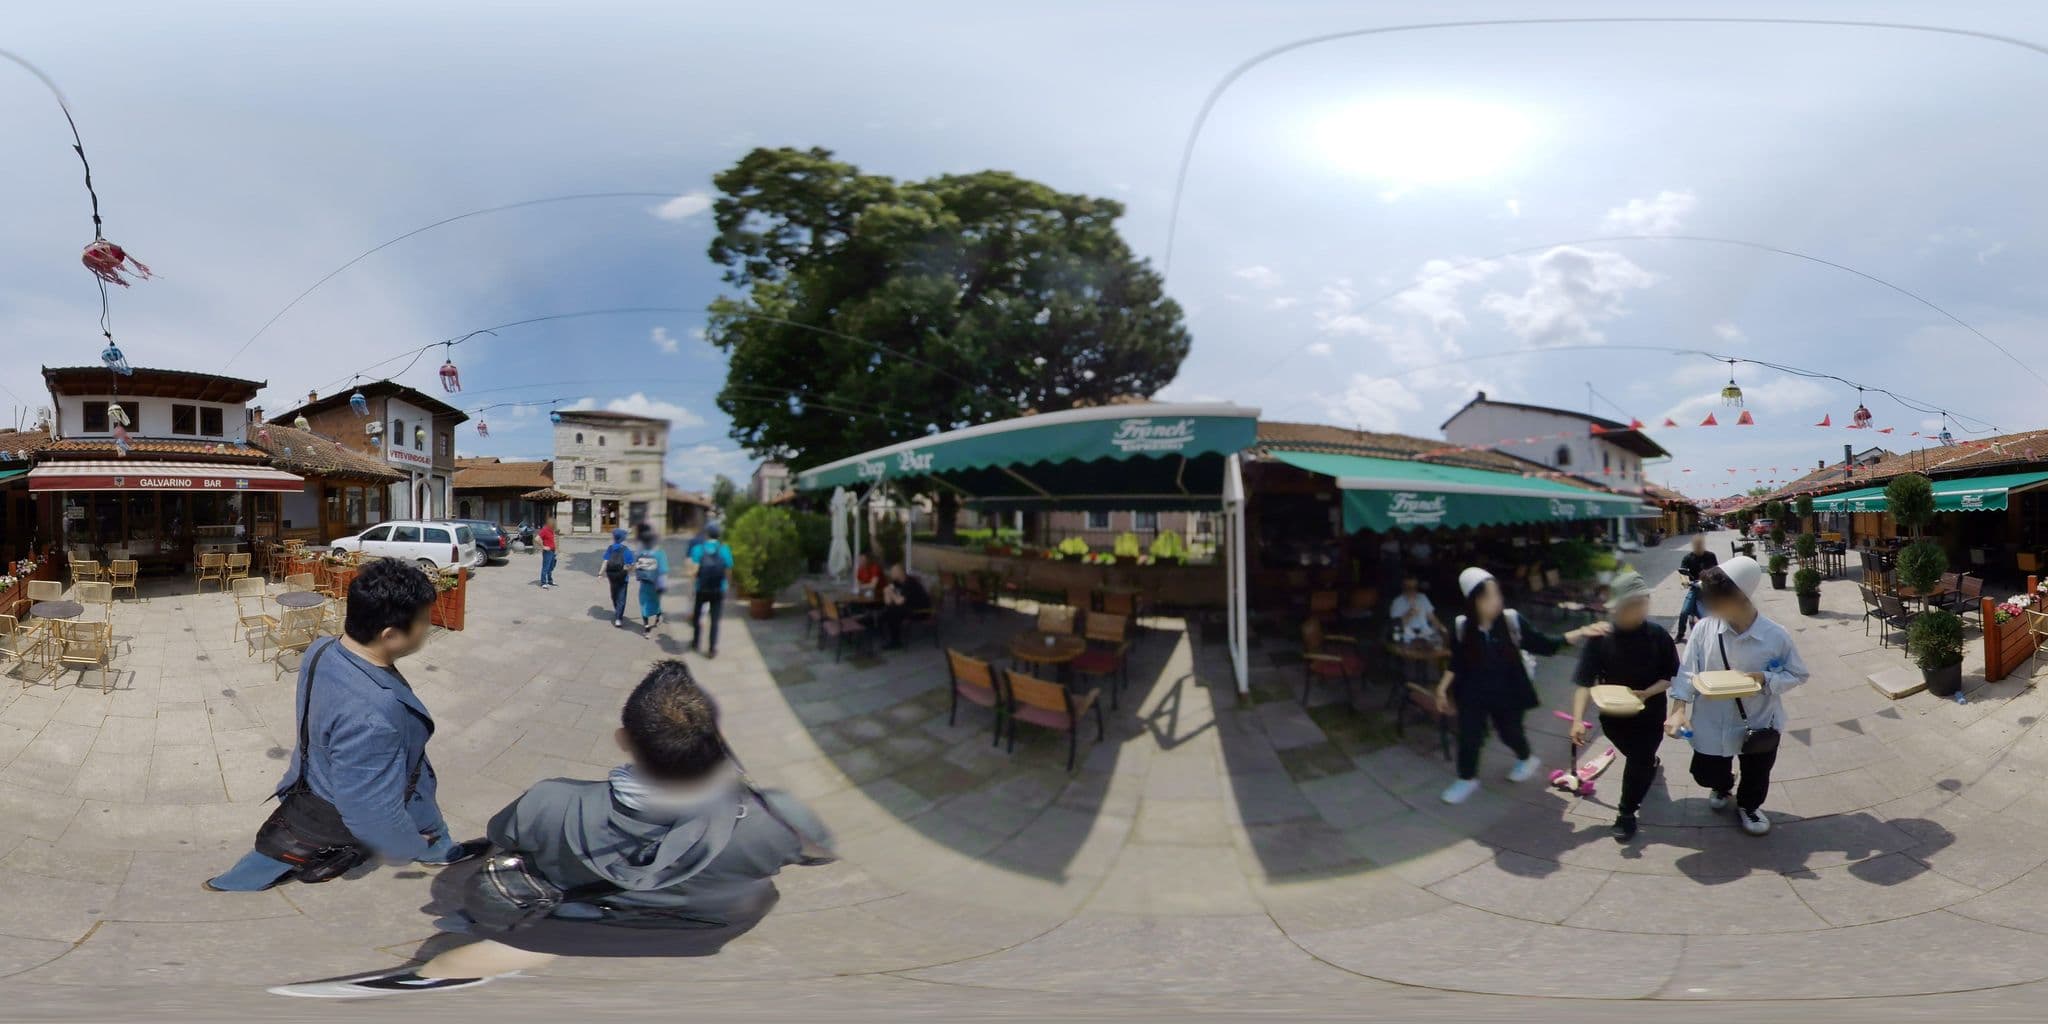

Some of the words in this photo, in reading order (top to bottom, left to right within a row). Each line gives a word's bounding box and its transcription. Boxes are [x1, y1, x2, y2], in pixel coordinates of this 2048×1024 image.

[1113, 417, 1195, 441] Franck
[897, 450, 934, 471] Bar
[139, 478, 192, 488] GALVARINO
[203, 479, 222, 488] BAR
